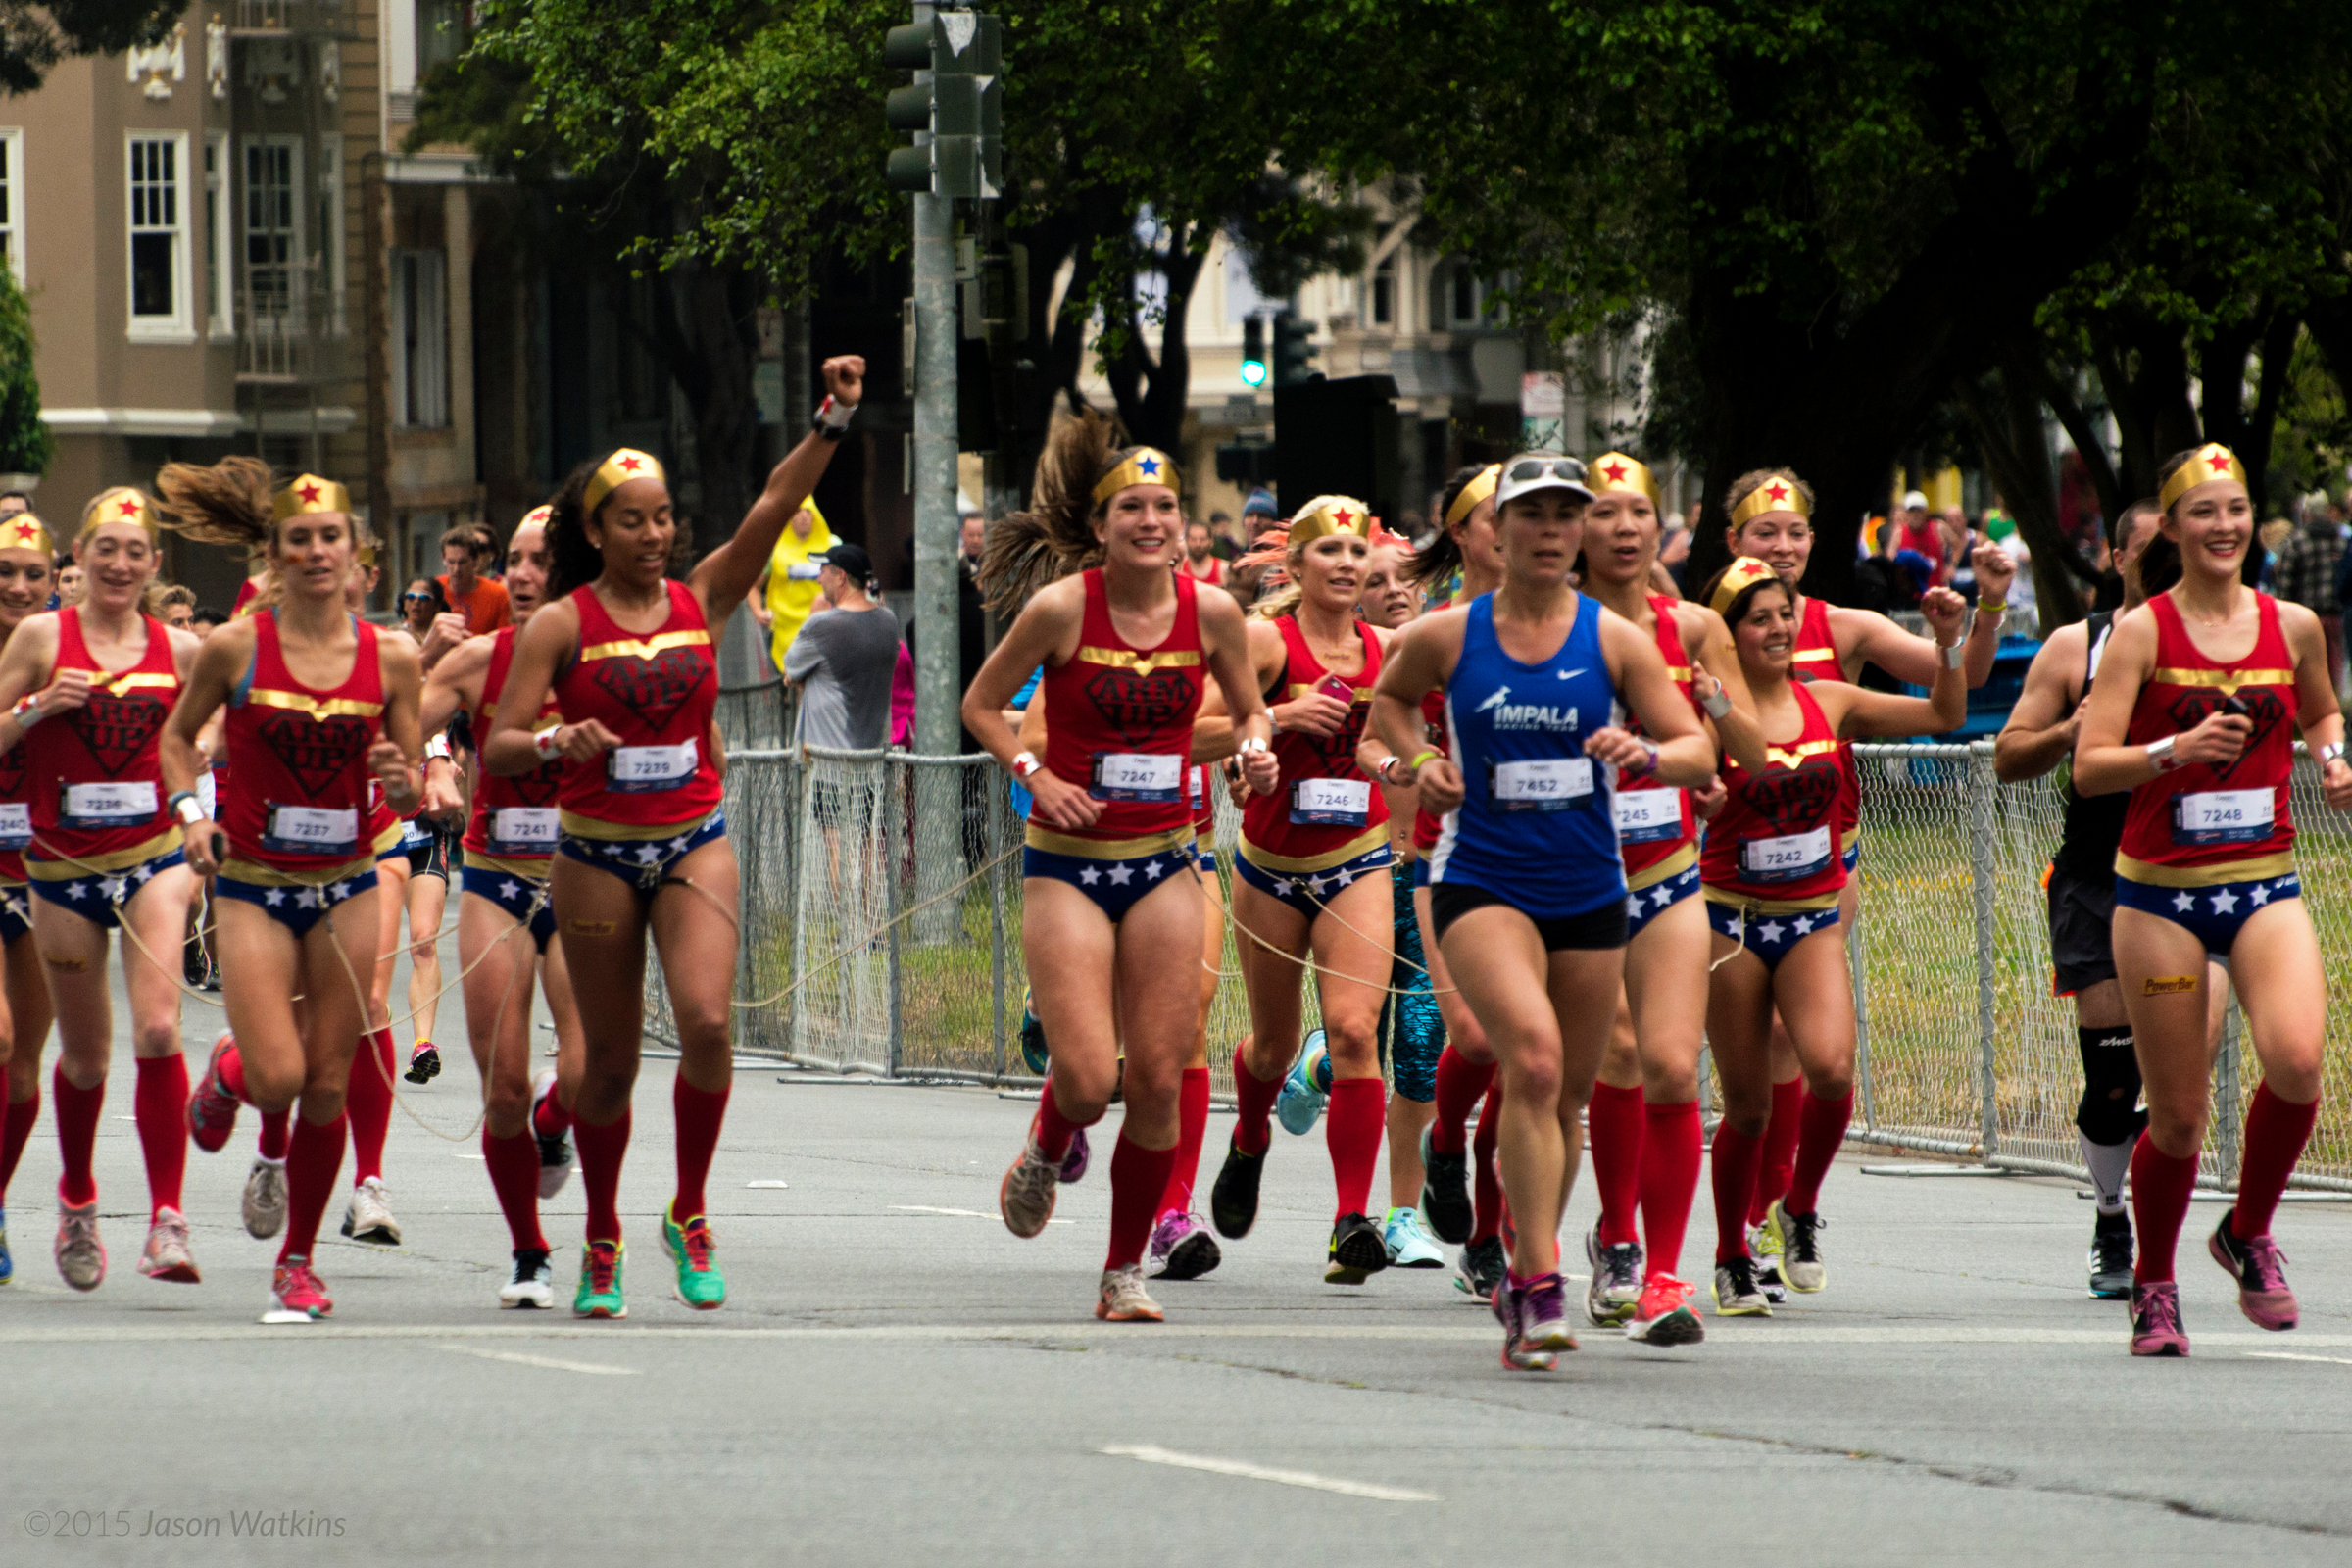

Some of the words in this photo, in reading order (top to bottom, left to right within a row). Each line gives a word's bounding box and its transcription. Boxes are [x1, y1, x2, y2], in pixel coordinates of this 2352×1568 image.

[1097, 677, 1186, 702] ARM
[1109, 704, 1173, 725] UP
[1494, 704, 1579, 724] IMPALA
[270, 719, 370, 745] ARM
[286, 746, 346, 770] UP
[633, 762, 671, 774] 7239
[1120, 770, 1157, 783] 7247
[1516, 779, 1558, 793] 7452
[1316, 794, 1349, 806] 7246
[2203, 808, 2243, 823] 7248
[0, 819, 26, 831] 240
[294, 823, 331, 837] 7237
[514, 824, 548, 836] 7241
[1766, 850, 1804, 865] 7242
